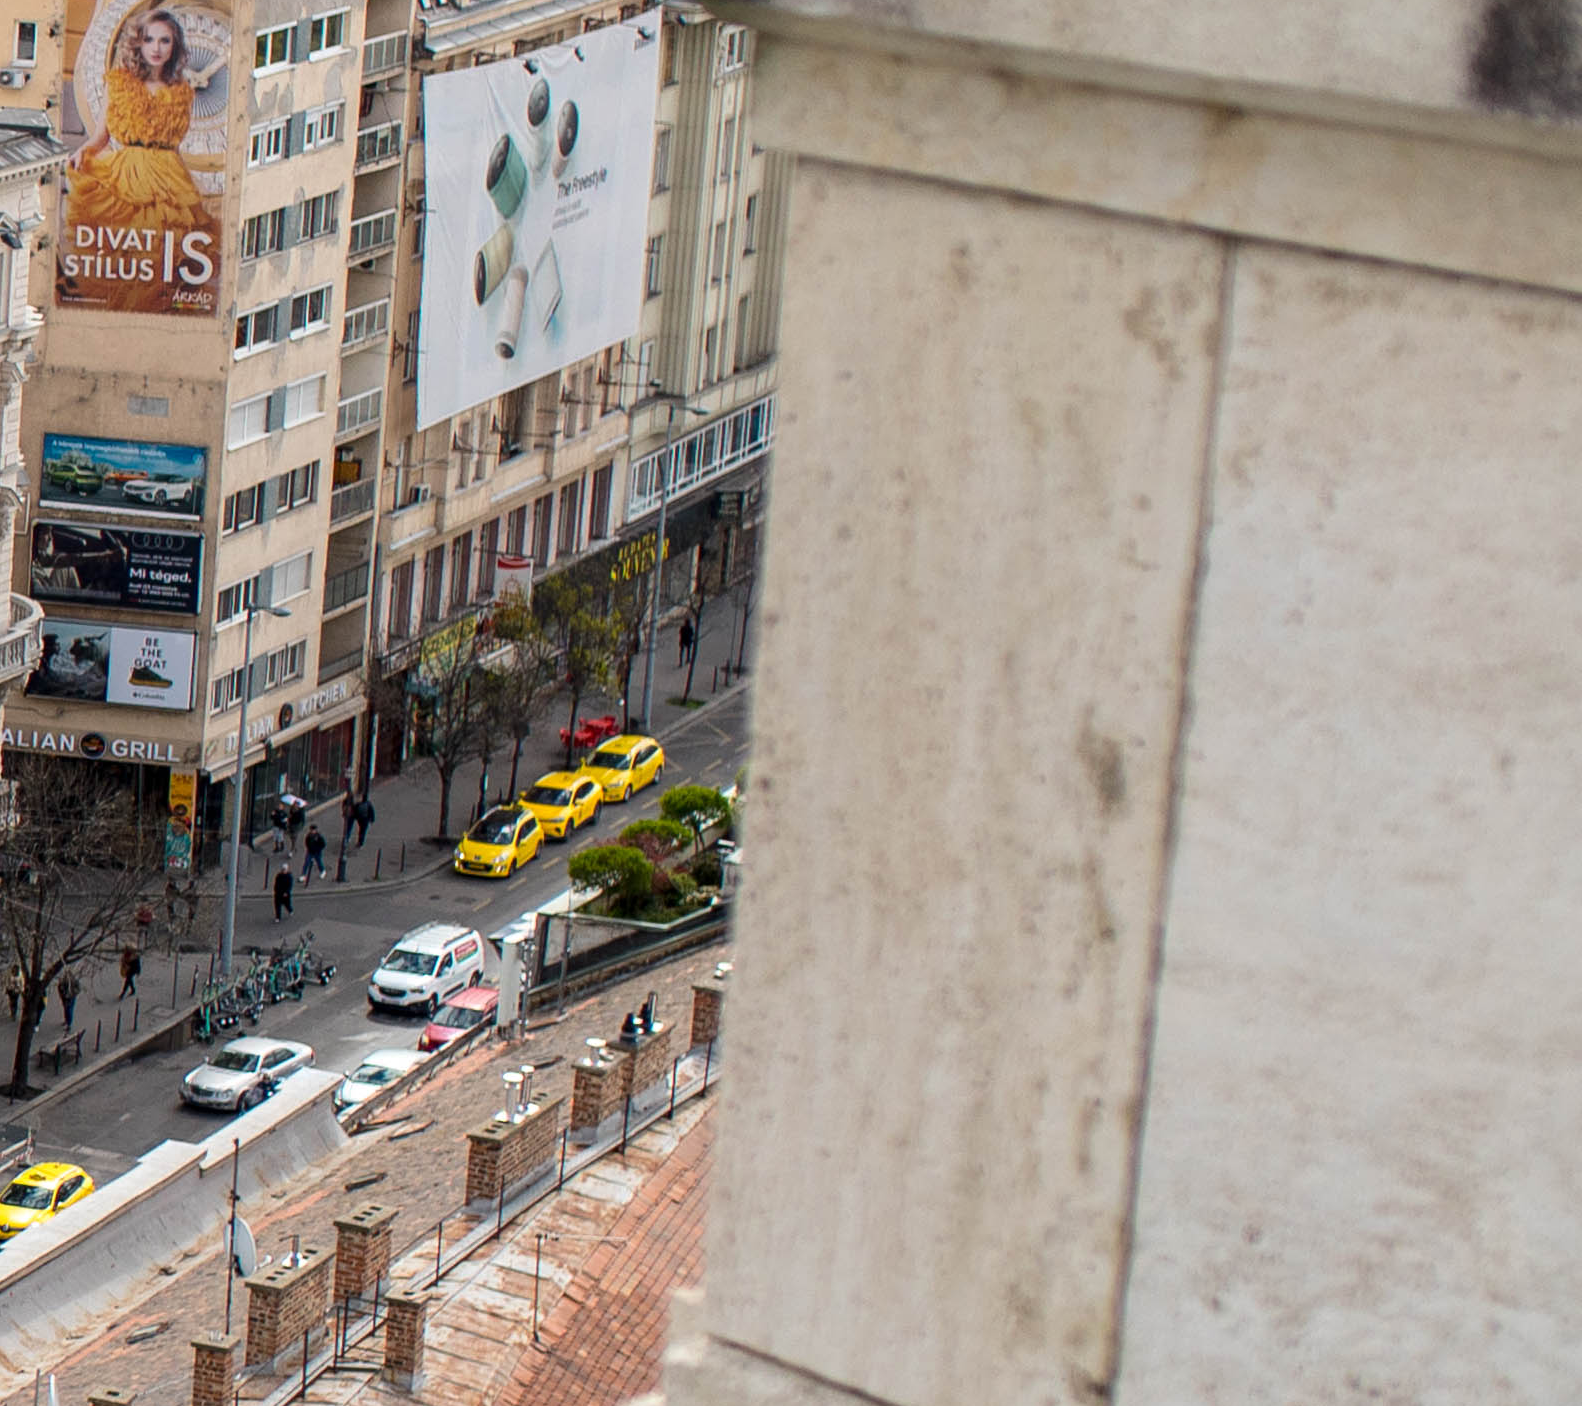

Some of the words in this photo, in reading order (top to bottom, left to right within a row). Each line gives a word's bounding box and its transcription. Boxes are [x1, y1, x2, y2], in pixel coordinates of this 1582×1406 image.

[572, 167, 608, 194] Freestyle
[75, 225, 156, 251] DIVAT
[63, 250, 154, 281] STÍLUS
[163, 230, 214, 285] IS
[129, 567, 146, 579] Mi
[149, 568, 192, 584] téged.
[141, 648, 162, 658] THE
[145, 638, 159, 647] BE
[134, 658, 167, 669] GOAT
[224, 714, 275, 754] ITLIAN
[299, 681, 348, 719] KITCHEN
[1, 727, 76, 752] ALIAN
[111, 739, 181, 763] GRILL
